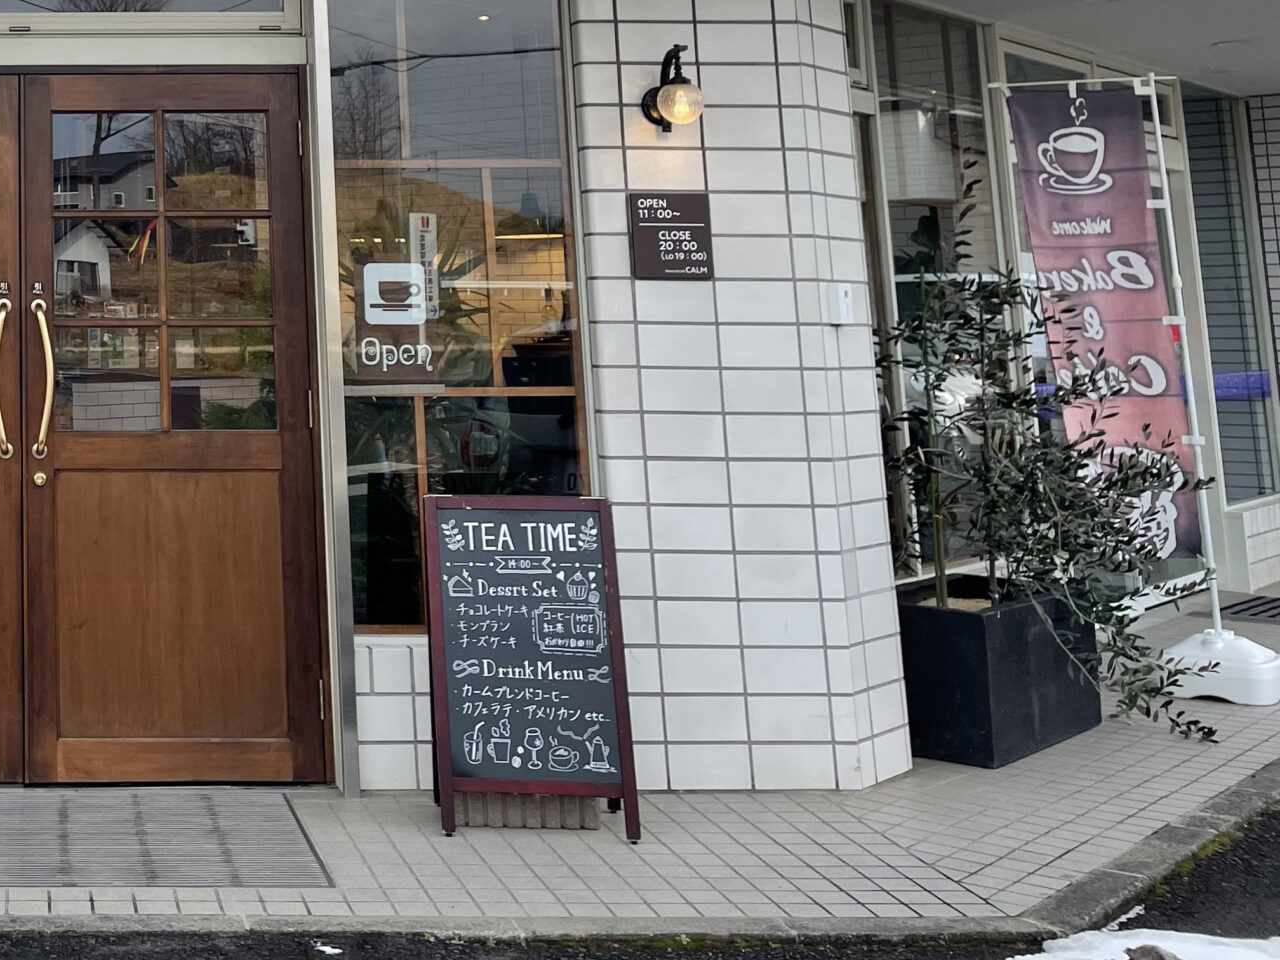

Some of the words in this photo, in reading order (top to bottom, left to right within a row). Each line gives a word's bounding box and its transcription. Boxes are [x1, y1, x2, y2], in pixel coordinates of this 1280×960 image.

[637, 198, 667, 208] OPEN
[658, 230, 691, 240] CLOSE
[685, 266, 708, 274] CALM
[361, 337, 434, 372] Open
[463, 522, 515, 551] TEA
[520, 522, 578, 552] TIME
[532, 580, 559, 598] Set
[576, 613, 594, 623] HOT
[576, 624, 595, 634] ICE
[481, 659, 534, 679] Drink
[537, 661, 584, 681] Menu
